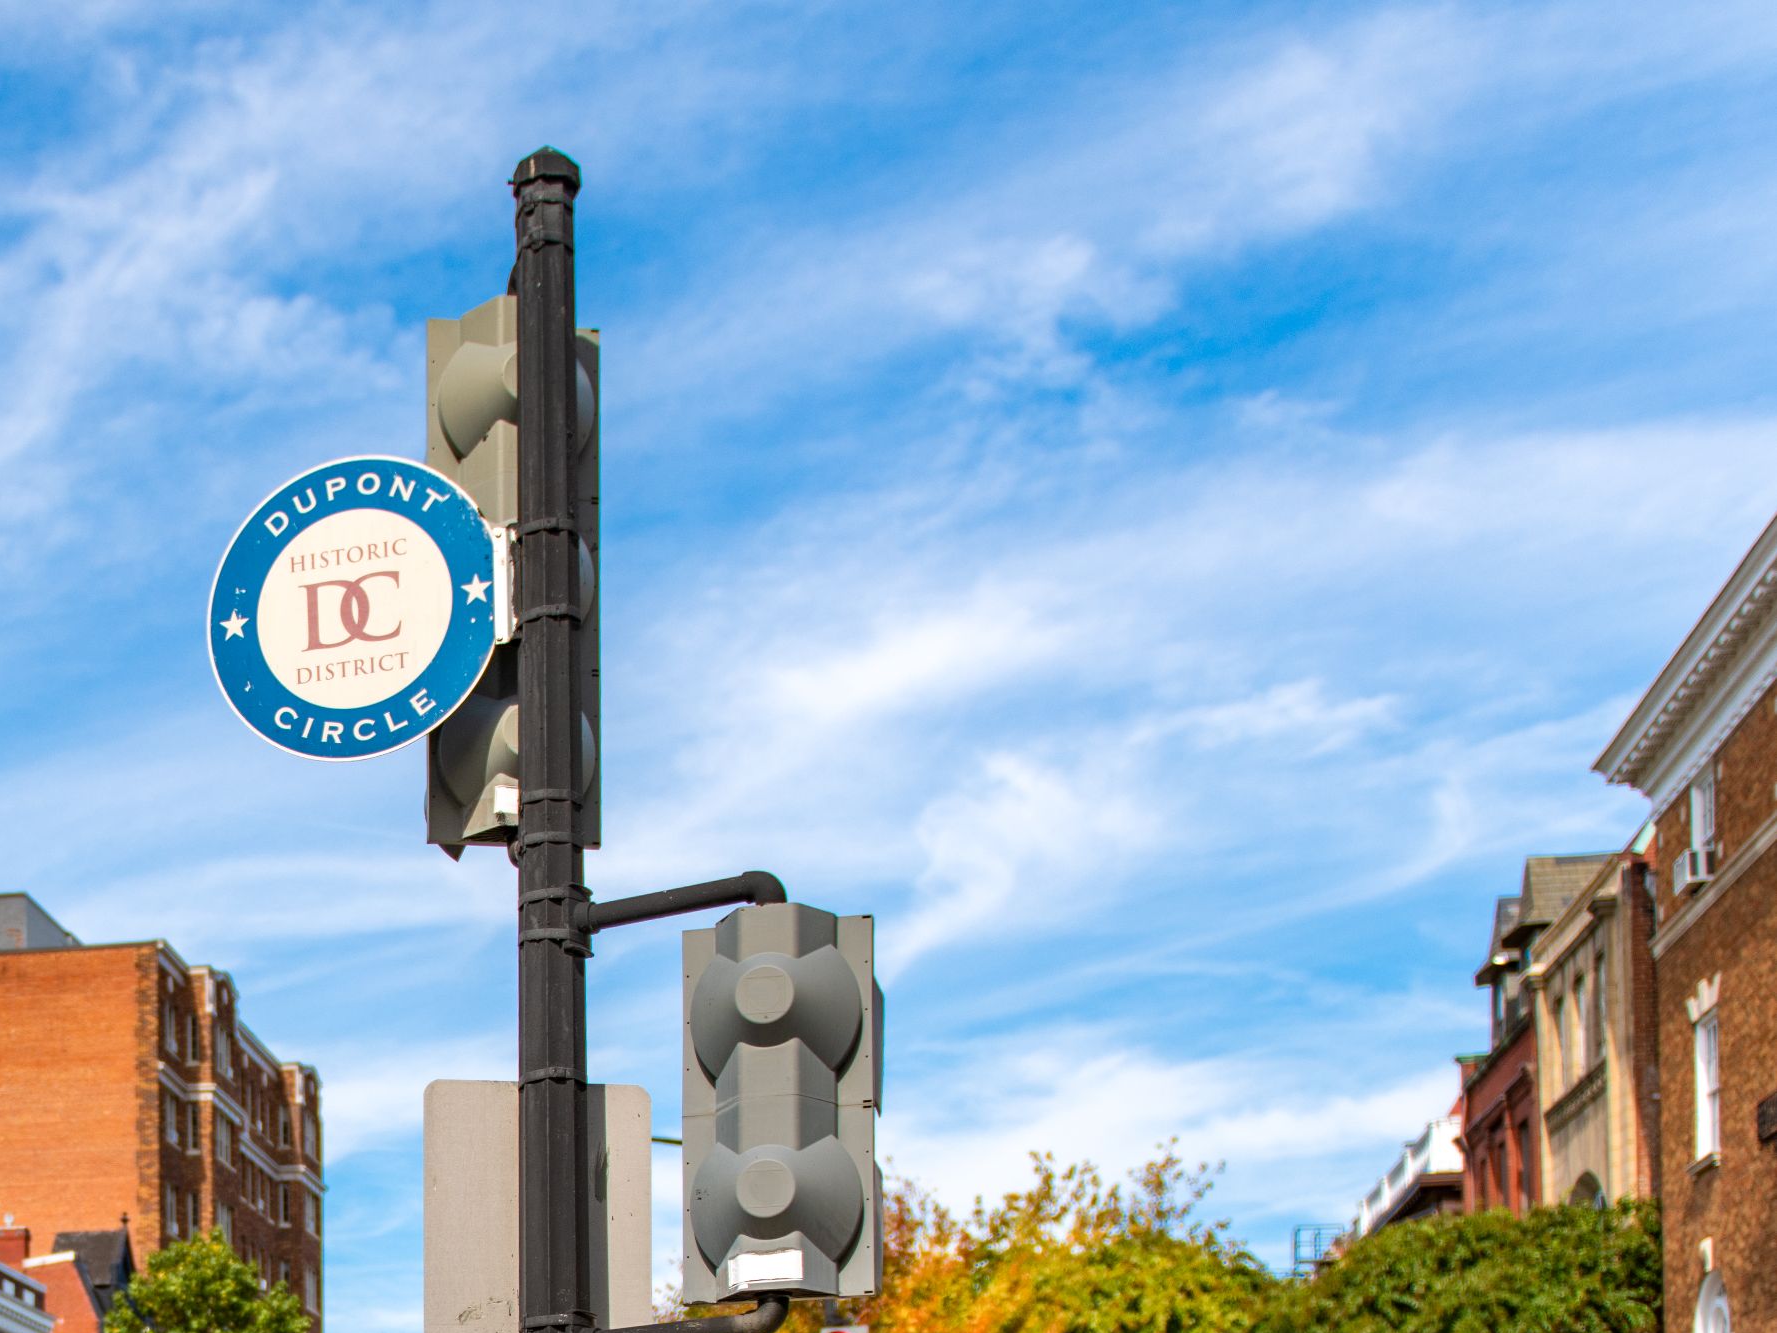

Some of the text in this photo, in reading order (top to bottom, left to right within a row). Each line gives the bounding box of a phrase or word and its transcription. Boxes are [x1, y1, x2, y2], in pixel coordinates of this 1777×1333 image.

[264, 472, 450, 538] DUPONT
[289, 538, 408, 573] HISTORIC
[298, 570, 403, 653] DC
[296, 651, 410, 686] DISTRICT
[273, 688, 437, 744] CIRCLE
